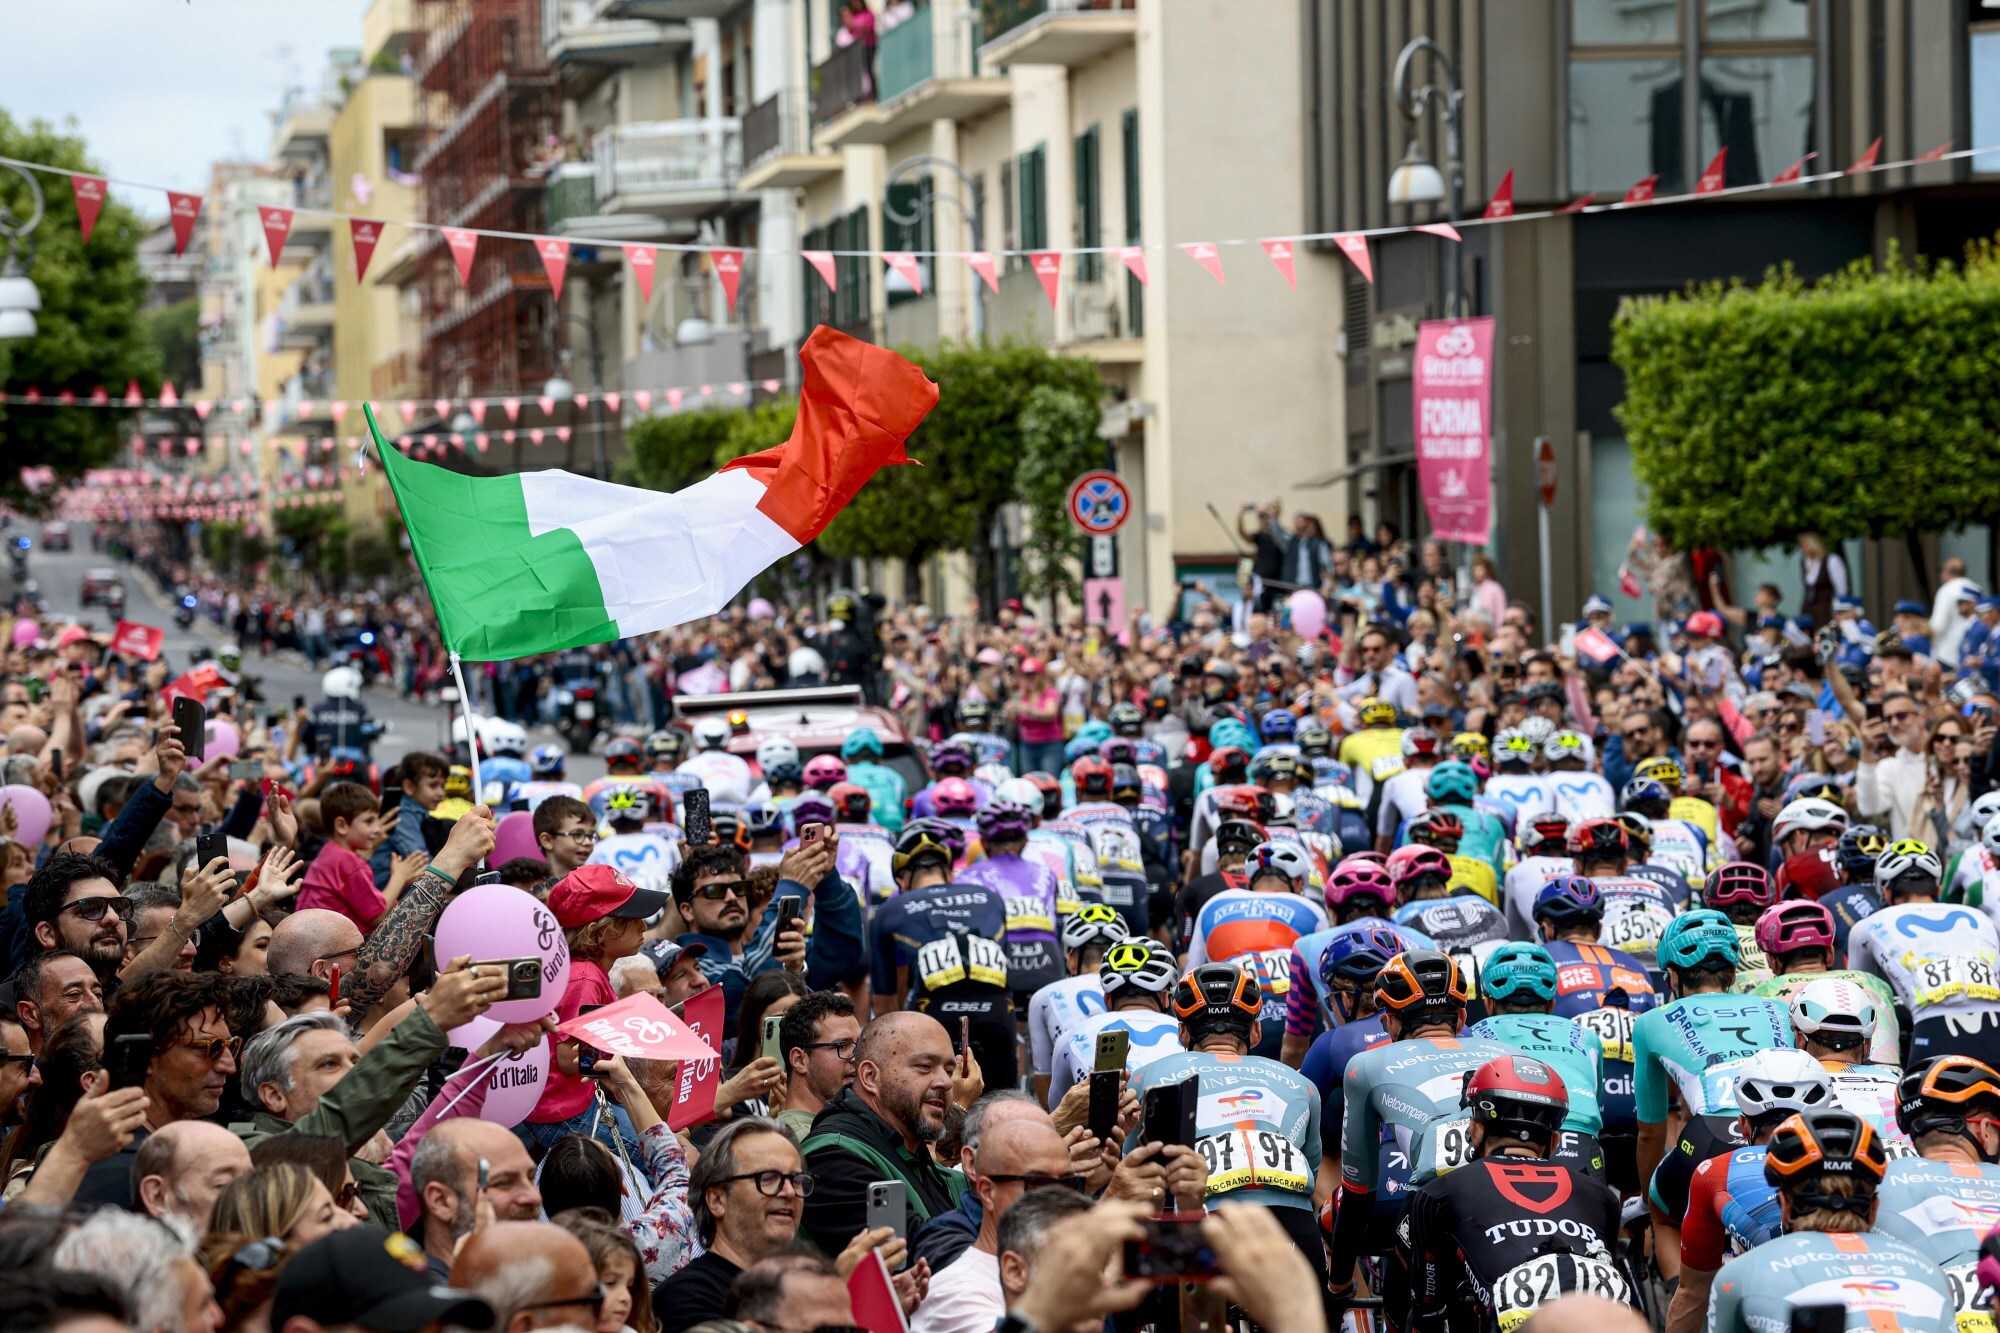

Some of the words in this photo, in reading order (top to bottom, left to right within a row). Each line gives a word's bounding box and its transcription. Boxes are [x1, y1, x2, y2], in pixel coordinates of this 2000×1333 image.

[933, 893, 988, 906] UBS
[1611, 914, 1645, 945] 135
[1702, 928, 1728, 936] BRIKO
[543, 952, 563, 983] Giro
[923, 943, 957, 976] 114
[974, 943, 1007, 970] 114
[1559, 967, 1593, 981] PIC
[1561, 974, 1596, 989] NIC
[1924, 960, 1951, 988] 87
[1967, 961, 1991, 986] 87
[941, 1001, 993, 1012] Q36.5
[1208, 1006, 1230, 1015] KASK
[1426, 997, 1447, 1005] KASK
[1692, 1006, 1760, 1018] CSF
[1665, 1005, 1710, 1058] BARDIANI
[1520, 1044, 1574, 1055] ABER
[1385, 1050, 1500, 1075] Netcompa
[500, 1064, 538, 1088] d'Italia
[1159, 1066, 1301, 1090] Netcompany
[1381, 1093, 1432, 1125] Netcompany
[1522, 1093, 1546, 1102] TUDOR
[1902, 1098, 1923, 1113] KASK
[1197, 1132, 1234, 1176] 97
[1259, 1131, 1294, 1172] 97
[1823, 1161, 1853, 1171] KASK
[1206, 1175, 1252, 1193] TOGRANO
[1256, 1176, 1305, 1191] ALTOGRANO
[1890, 1174, 2000, 1188] Netcomp
[1485, 1219, 1597, 1246] TUDOR
[1770, 1251, 1934, 1275] Netcompany
[1824, 1264, 1907, 1277] INEOS
[1426, 1262, 1436, 1296] TUDOR
[1464, 1261, 1491, 1306] TUDOR
[1499, 1262, 1556, 1311] 182
